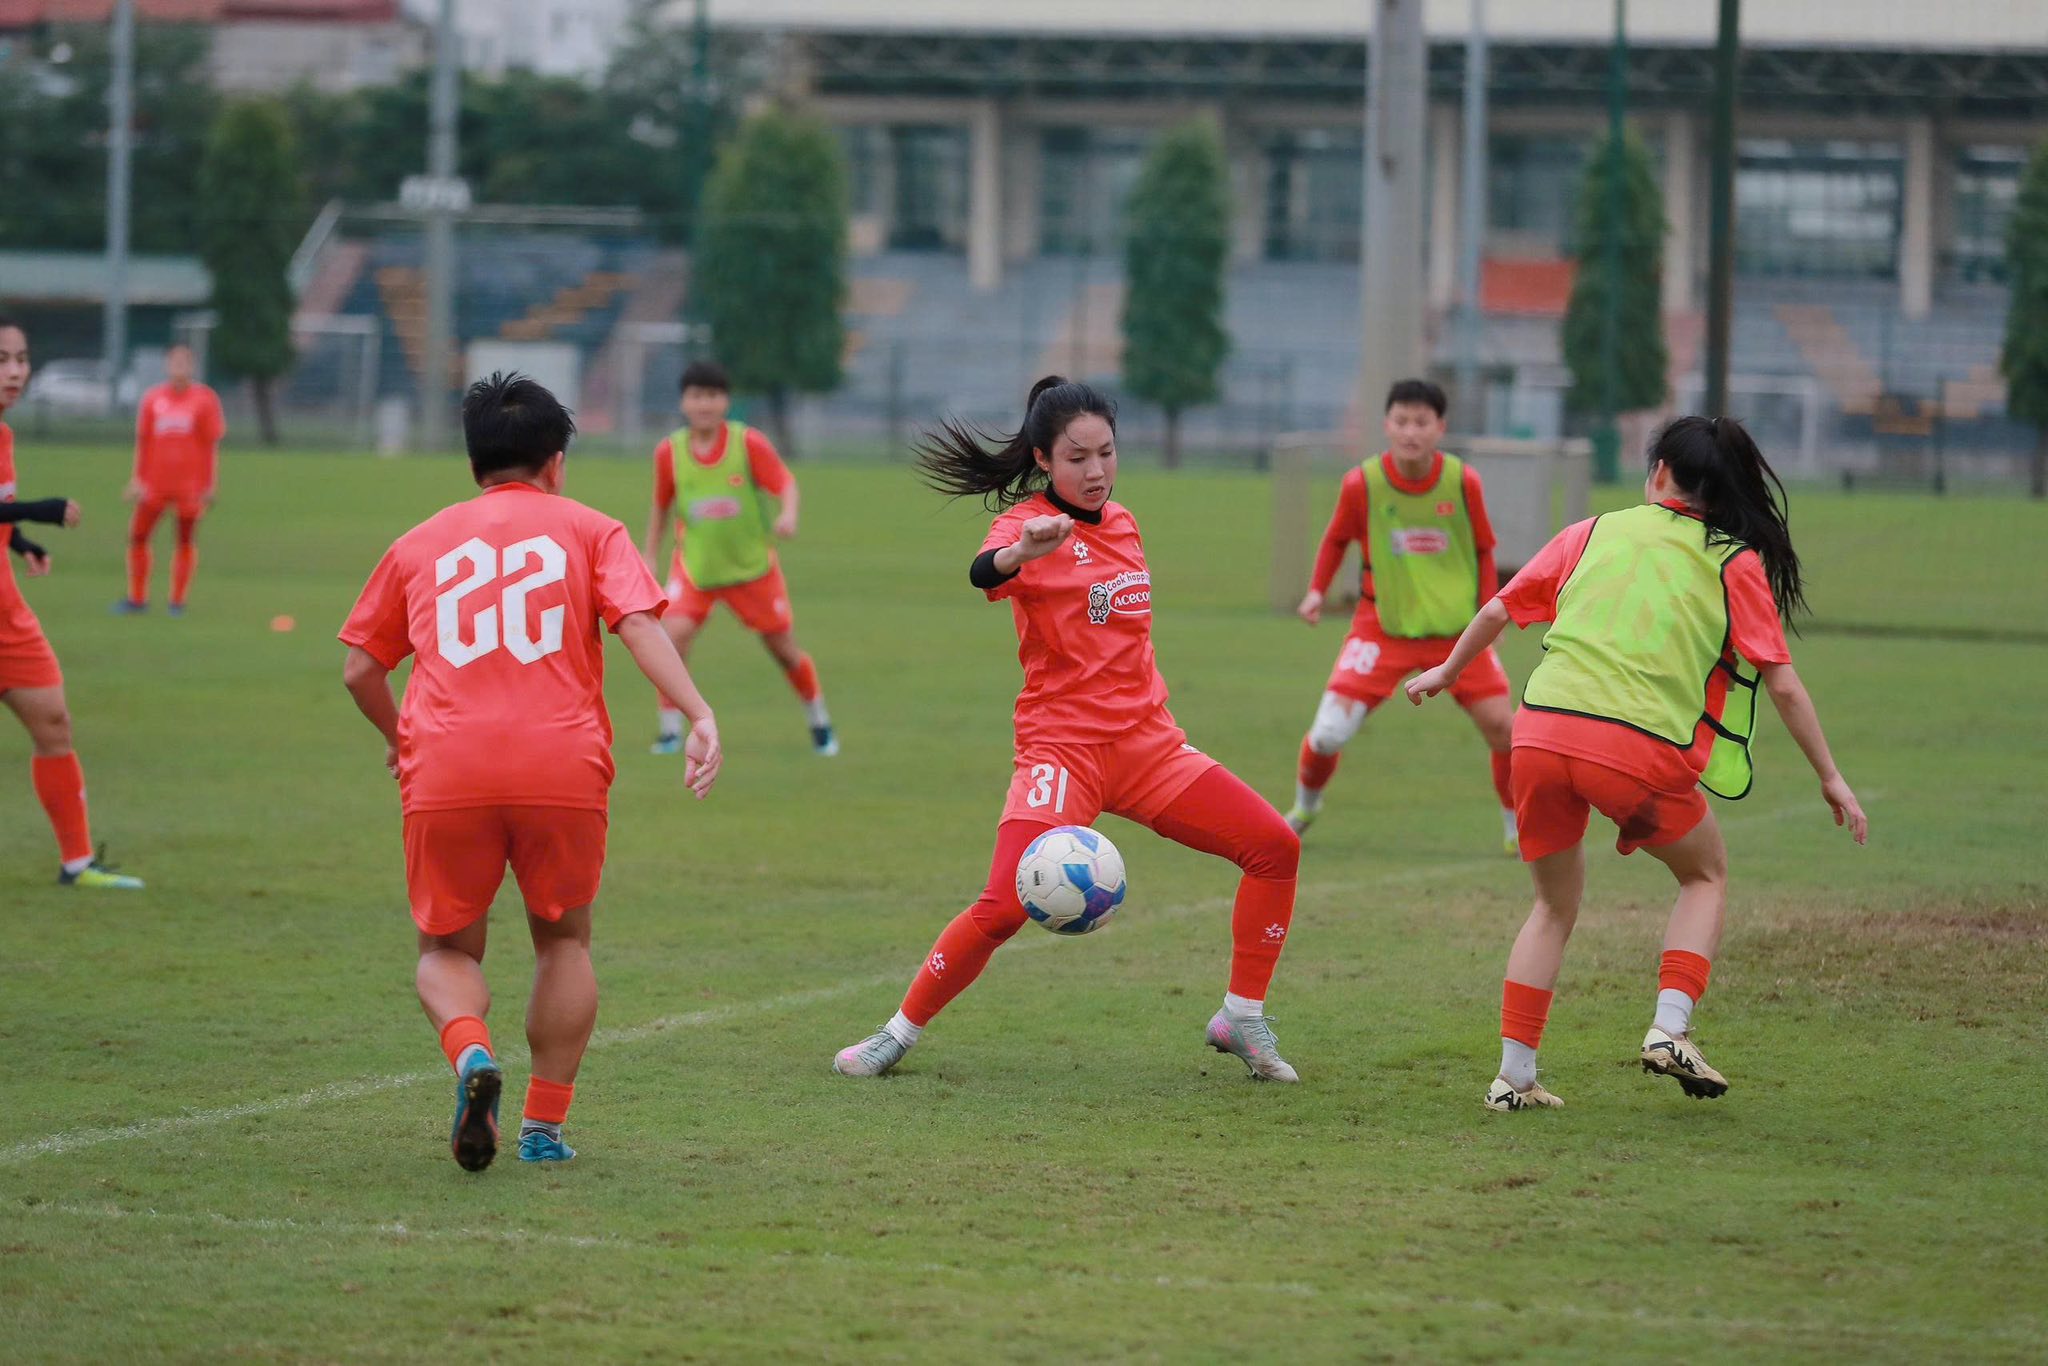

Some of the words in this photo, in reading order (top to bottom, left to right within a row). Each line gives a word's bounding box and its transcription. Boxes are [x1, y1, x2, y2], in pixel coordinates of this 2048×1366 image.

[435, 535, 567, 669] 22
[1107, 575, 1126, 591] Cook
[1127, 573, 1149, 583] happ
[1026, 763, 1069, 813] 31
